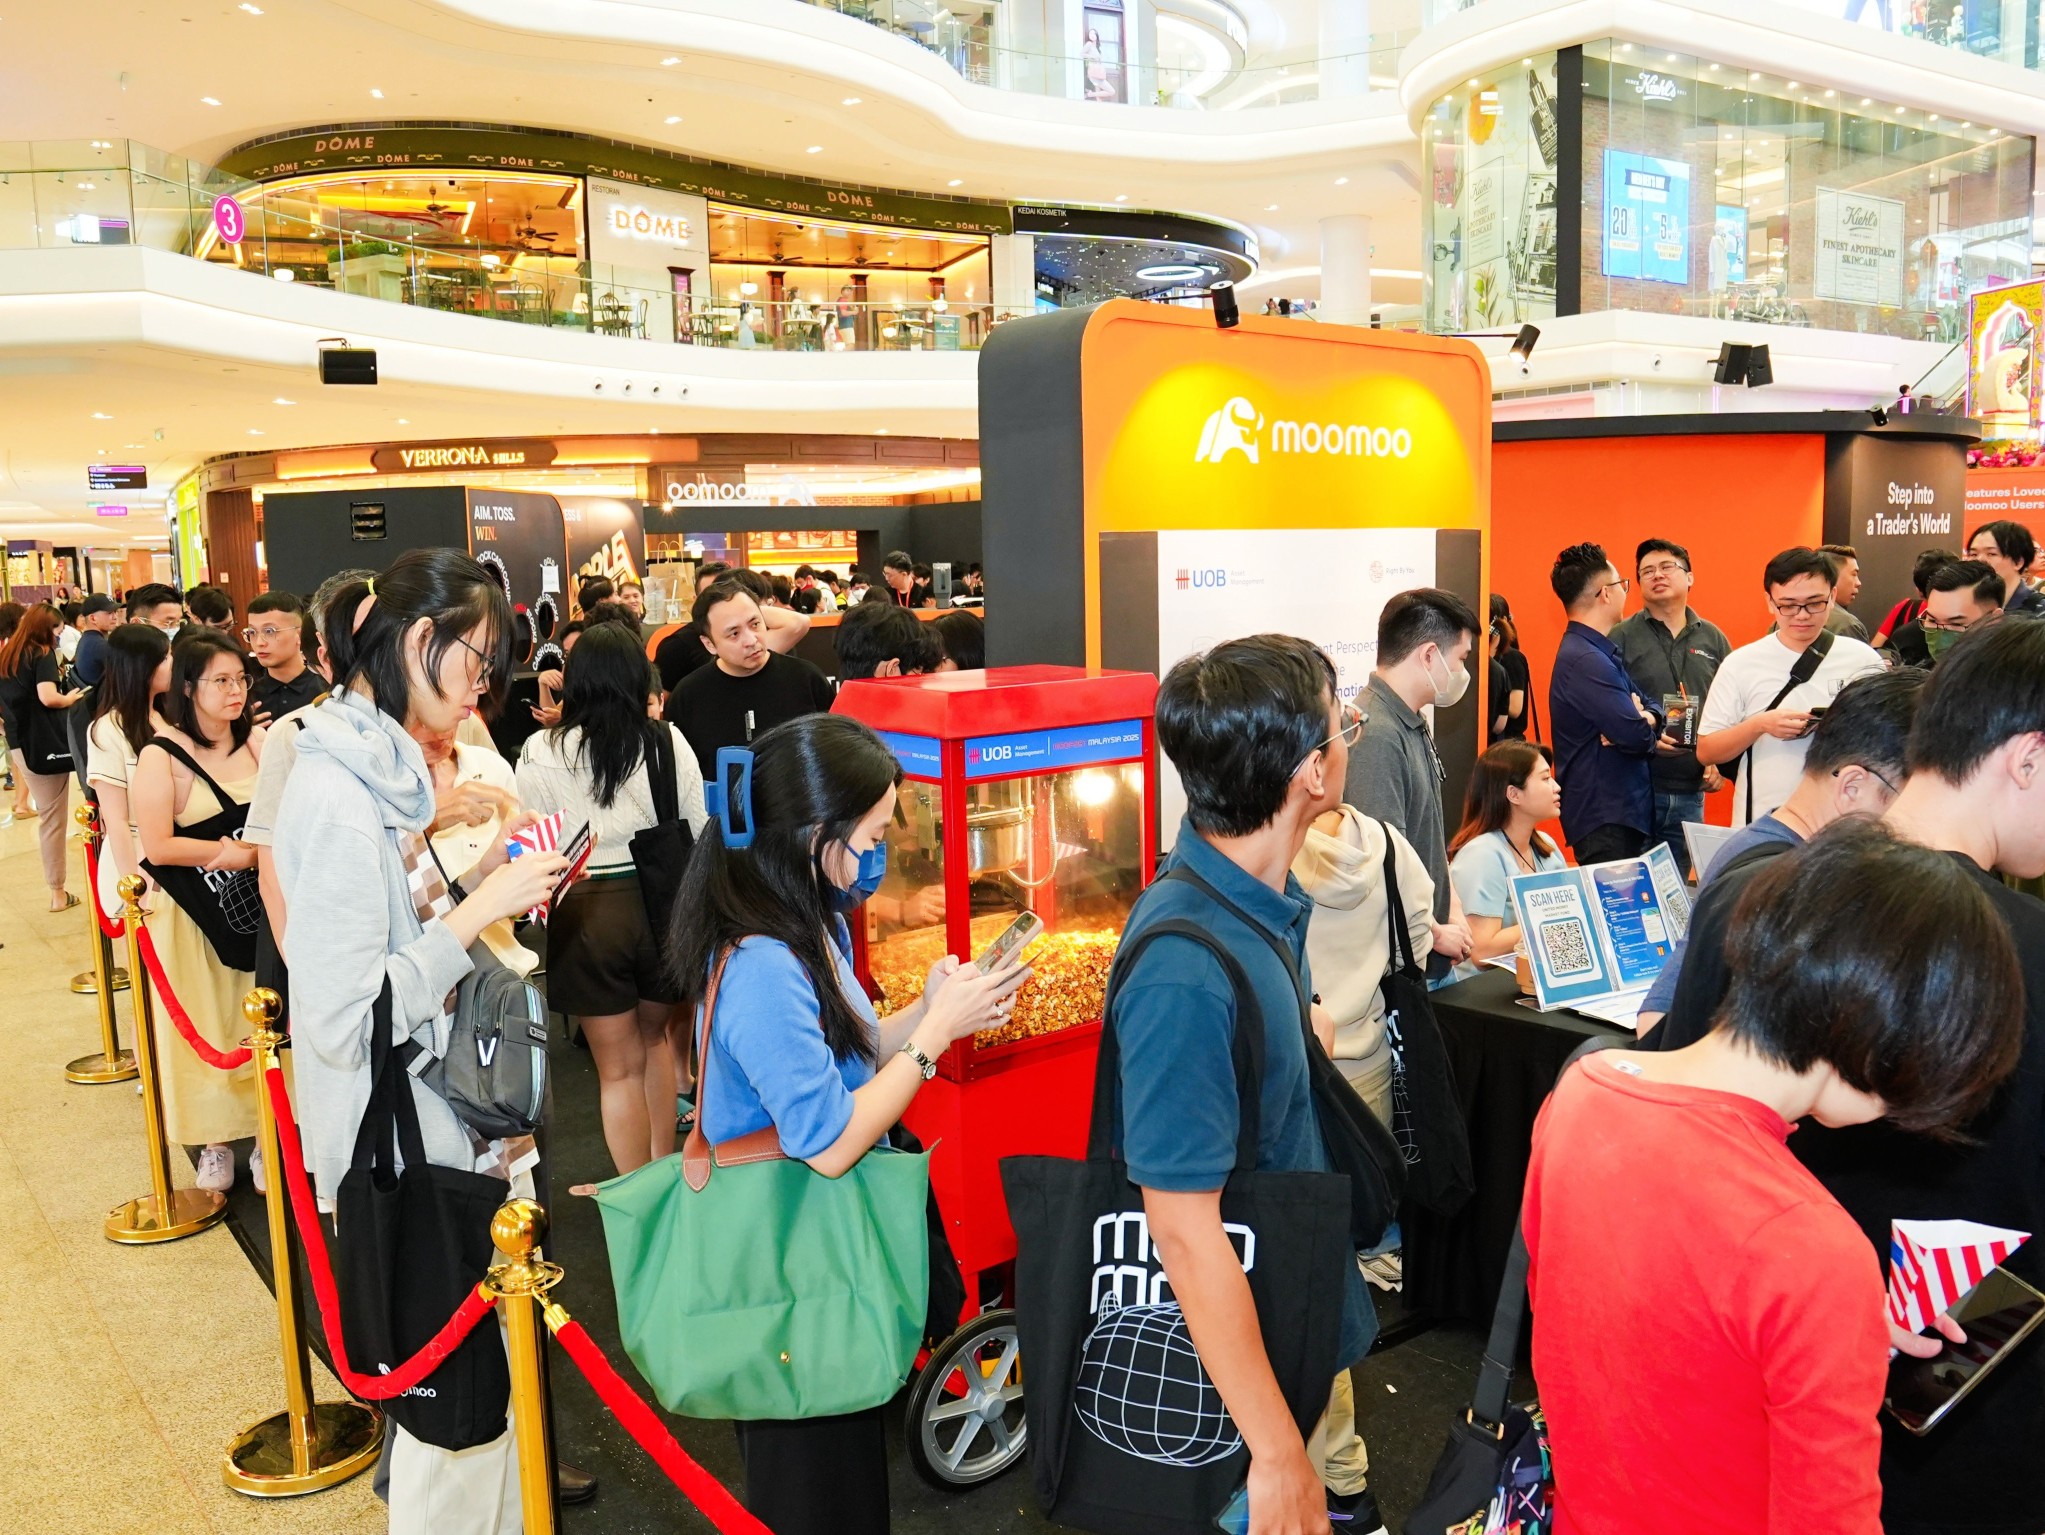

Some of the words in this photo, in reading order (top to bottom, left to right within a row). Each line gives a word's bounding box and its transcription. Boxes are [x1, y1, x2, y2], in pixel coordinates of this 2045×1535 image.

[1635, 72, 1677, 98] Kiehl's
[314, 136, 375, 153] DÔME
[377, 153, 410, 163] DÔME
[500, 156, 534, 167] DÔME
[273, 161, 299, 173] DÔME
[612, 169, 639, 181] DÔME
[591, 184, 620, 196] RESTORAN
[702, 186, 726, 198] DÔME
[786, 201, 811, 212] DÔME
[826, 190, 874, 208] DÔME
[871, 213, 895, 223] DÔME
[1017, 206, 1036, 215] KEDAI
[1037, 208, 1067, 217] KOSMETIK
[1842, 206, 1878, 227] Kiehl's
[221, 203, 236, 236] 3
[614, 208, 690, 240] DÔME
[956, 221, 980, 231] DÔME
[1822, 239, 1848, 251] FINEST
[1850, 244, 1896, 258] APOTHECARY
[1841, 255, 1878, 267] SKINCARE
[1271, 420, 1412, 458] moomoo
[492, 452, 525, 464] HILLS
[1887, 481, 1913, 510] Step
[1913, 482, 1935, 505] into
[1965, 488, 2011, 498] eatures
[1964, 501, 2008, 511] oomoo
[2010, 499, 2045, 510] Users
[474, 505, 492, 520] AIM.
[493, 507, 516, 521] TOSS.
[564, 508, 576, 521] ESS
[1867, 519, 1874, 536] a
[1875, 512, 1919, 535] Trader's
[1919, 512, 1951, 535] World
[475, 526, 497, 541] WIN.
[476, 550, 491, 563] TOCK
[502, 570, 512, 606] COUP
[1192, 569, 1227, 588] UOB
[1321, 643, 1333, 655] nt
[1336, 640, 1379, 656] Perspect
[1683, 708, 1694, 745] EXHIBITOR
[1087, 736, 1122, 747] MALAYSIA
[1122, 733, 1140, 743] 2025
[982, 744, 1012, 762] UOB
[1014, 744, 1028, 752] Asset
[1014, 748, 1045, 759] Management
[1530, 890, 1553, 908] SCAN
[1553, 887, 1576, 906] HERE
